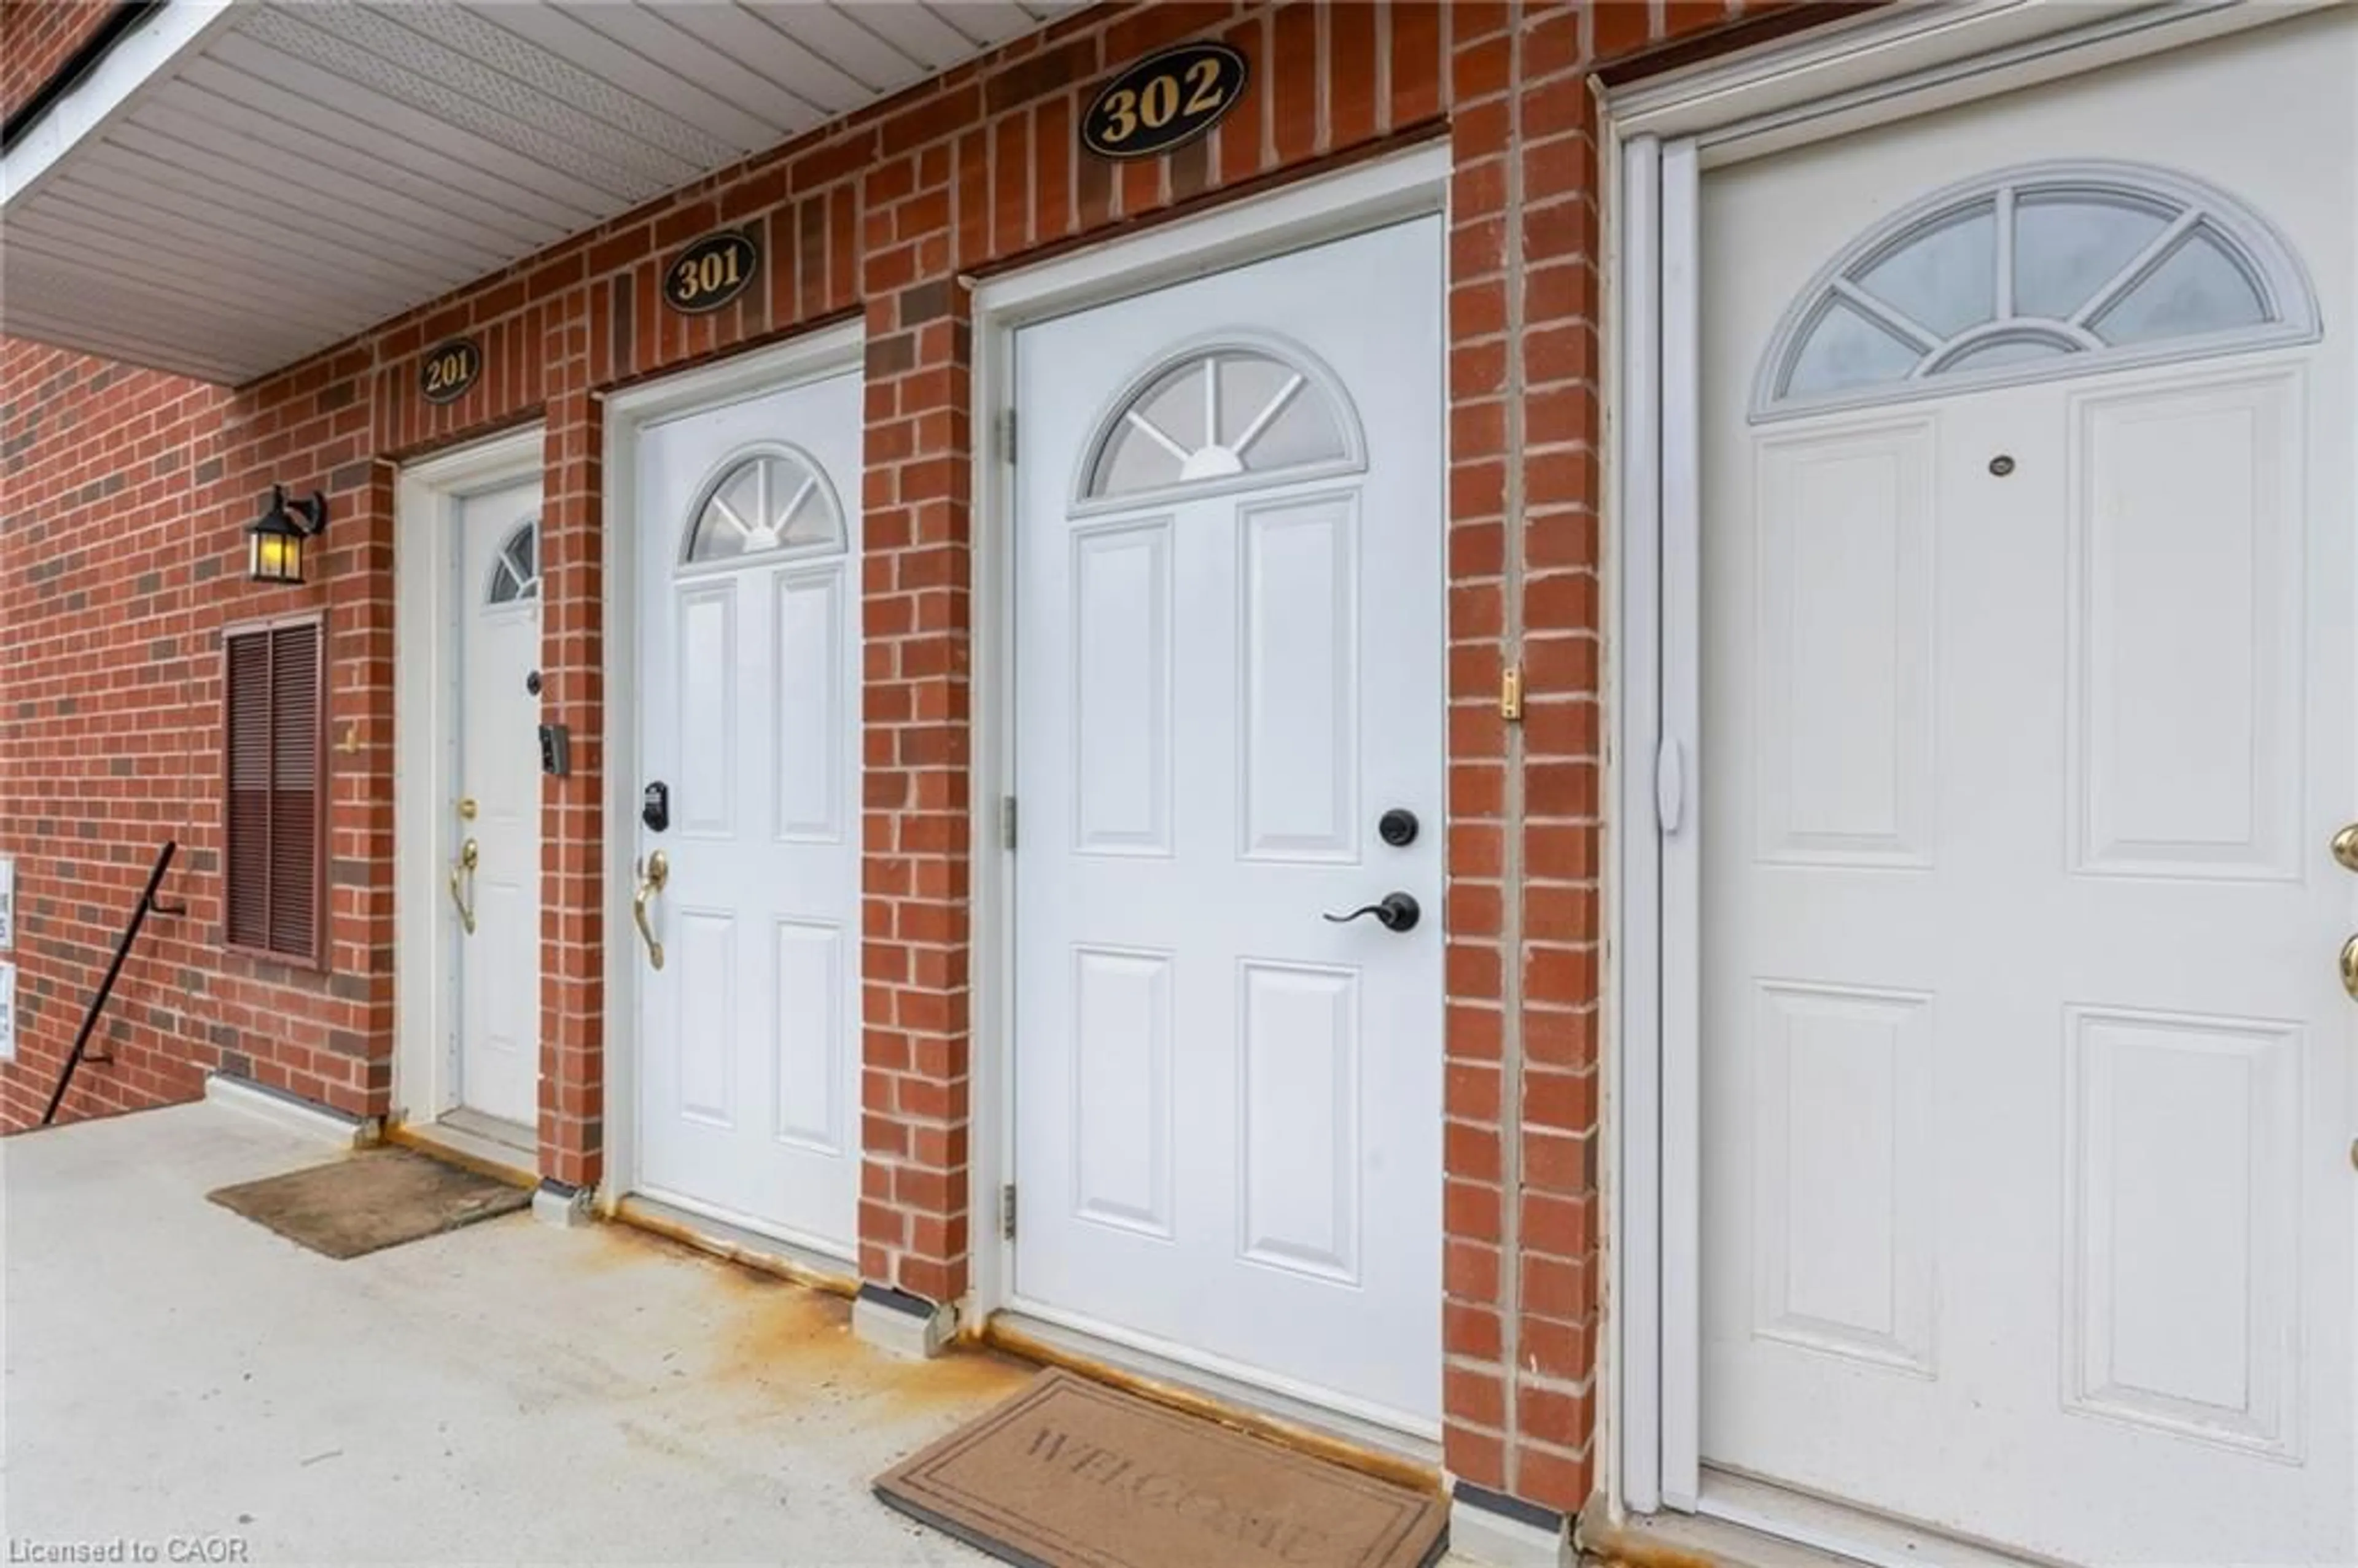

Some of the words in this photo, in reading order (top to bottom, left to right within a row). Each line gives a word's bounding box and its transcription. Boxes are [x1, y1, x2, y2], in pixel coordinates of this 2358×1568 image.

[1102, 58, 1223, 142] 302
[677, 244, 740, 300] 301
[427, 349, 468, 392] 201
